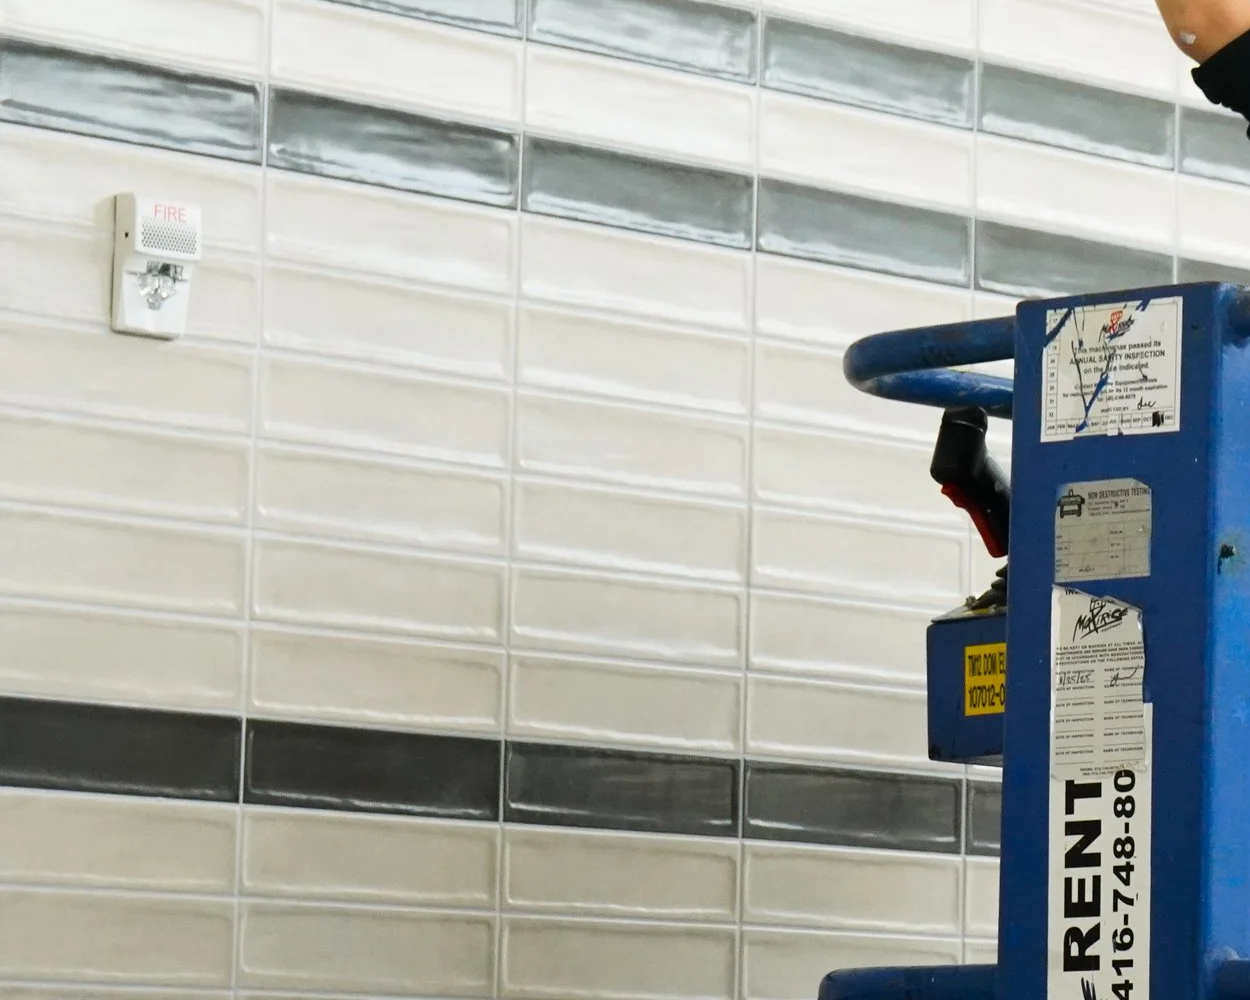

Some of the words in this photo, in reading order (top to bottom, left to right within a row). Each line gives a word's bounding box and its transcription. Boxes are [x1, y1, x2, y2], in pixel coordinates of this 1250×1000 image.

[154, 203, 188, 223] FIRE
[1128, 341, 1152, 350] passed
[1124, 350, 1166, 360] INSPECTION
[1098, 488, 1130, 499] DESTRUCTIVE
[1063, 779, 1102, 972] RENT
